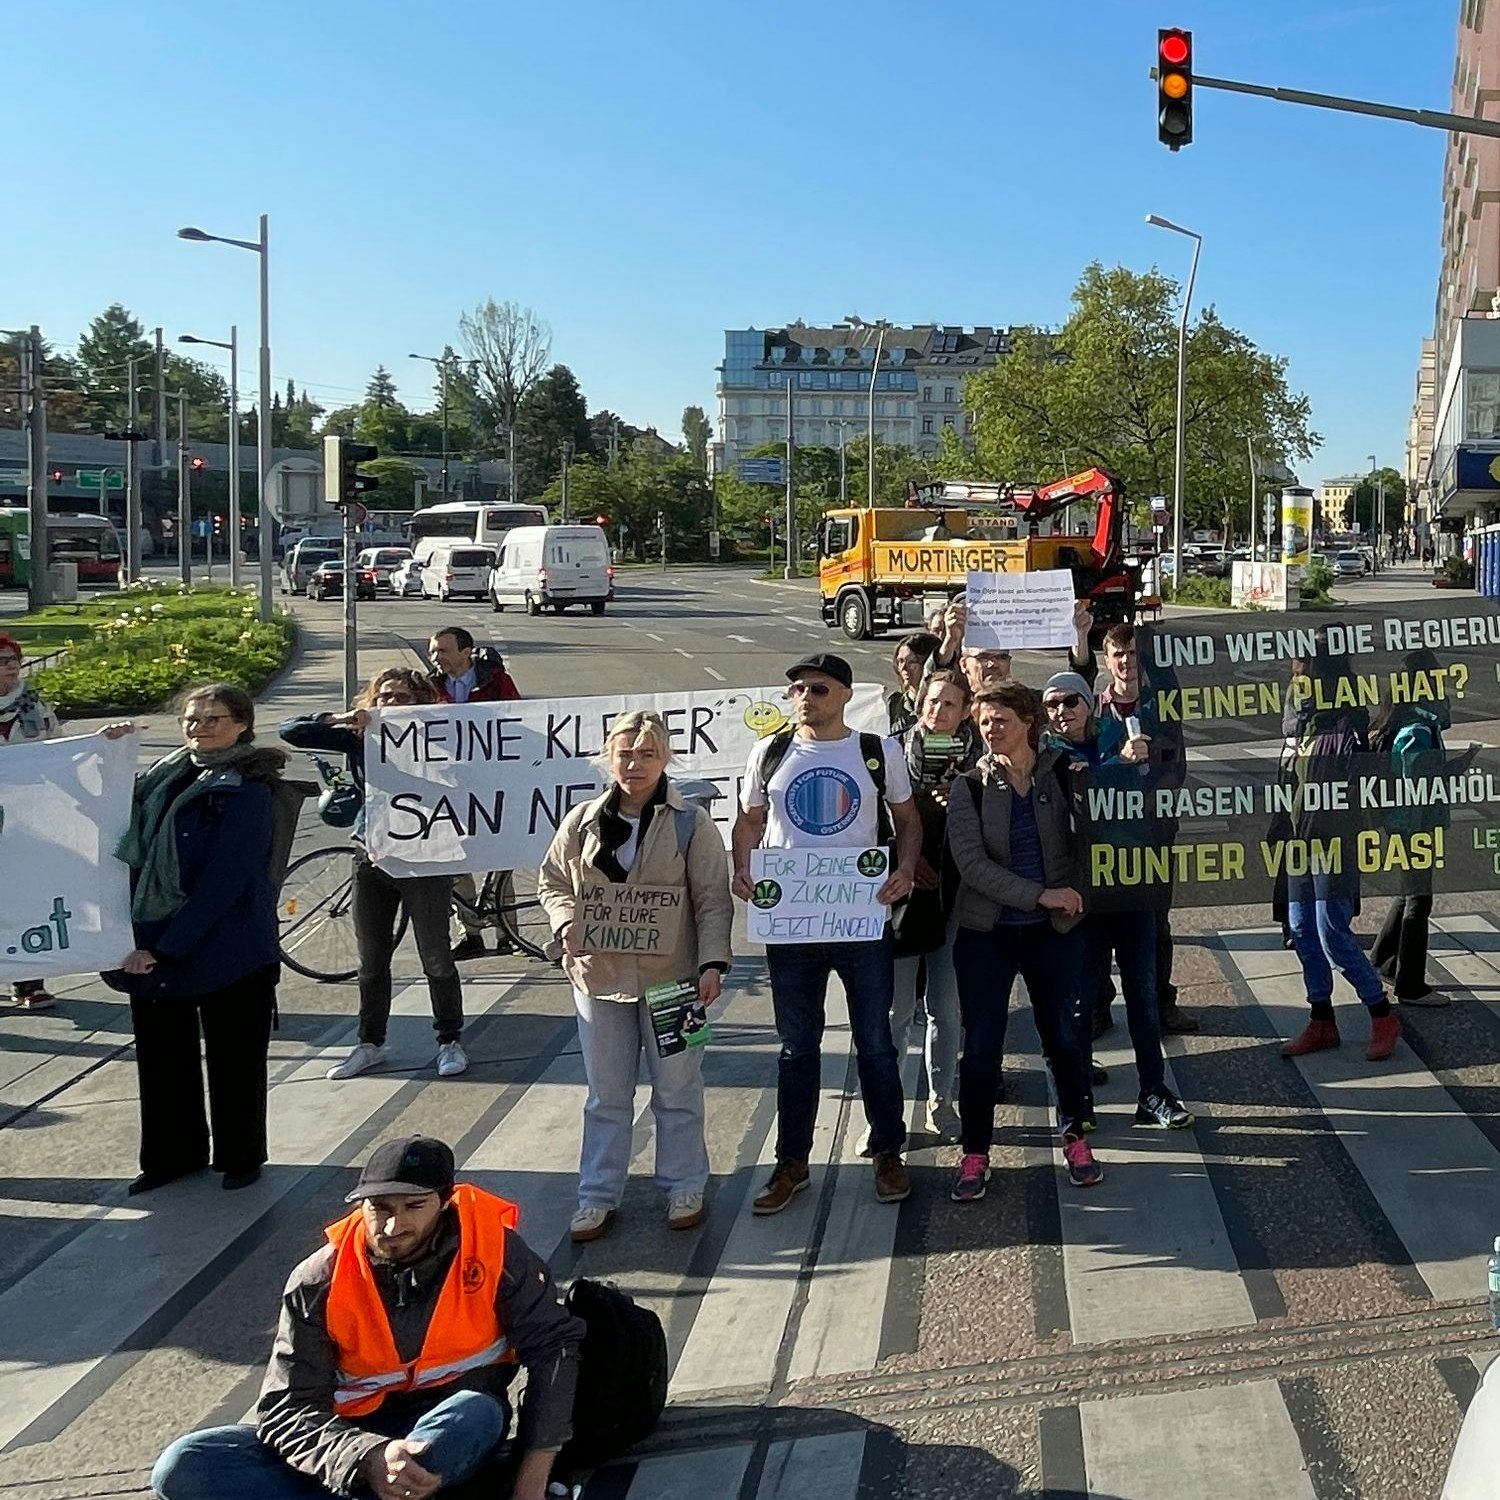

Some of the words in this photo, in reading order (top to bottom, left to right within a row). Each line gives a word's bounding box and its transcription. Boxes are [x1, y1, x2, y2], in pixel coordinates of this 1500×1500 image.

[968, 518, 1015, 527] LSTAND
[380, 717, 523, 764] MEINE
[387, 790, 505, 841] SAN
[614, 886, 680, 907] KÄMPFEN
[790, 880, 879, 905] ZUKUNFT
[7, 897, 72, 954] .at
[583, 902, 612, 921] FÜR
[618, 906, 660, 924] EURE
[583, 924, 660, 950] KINDER
